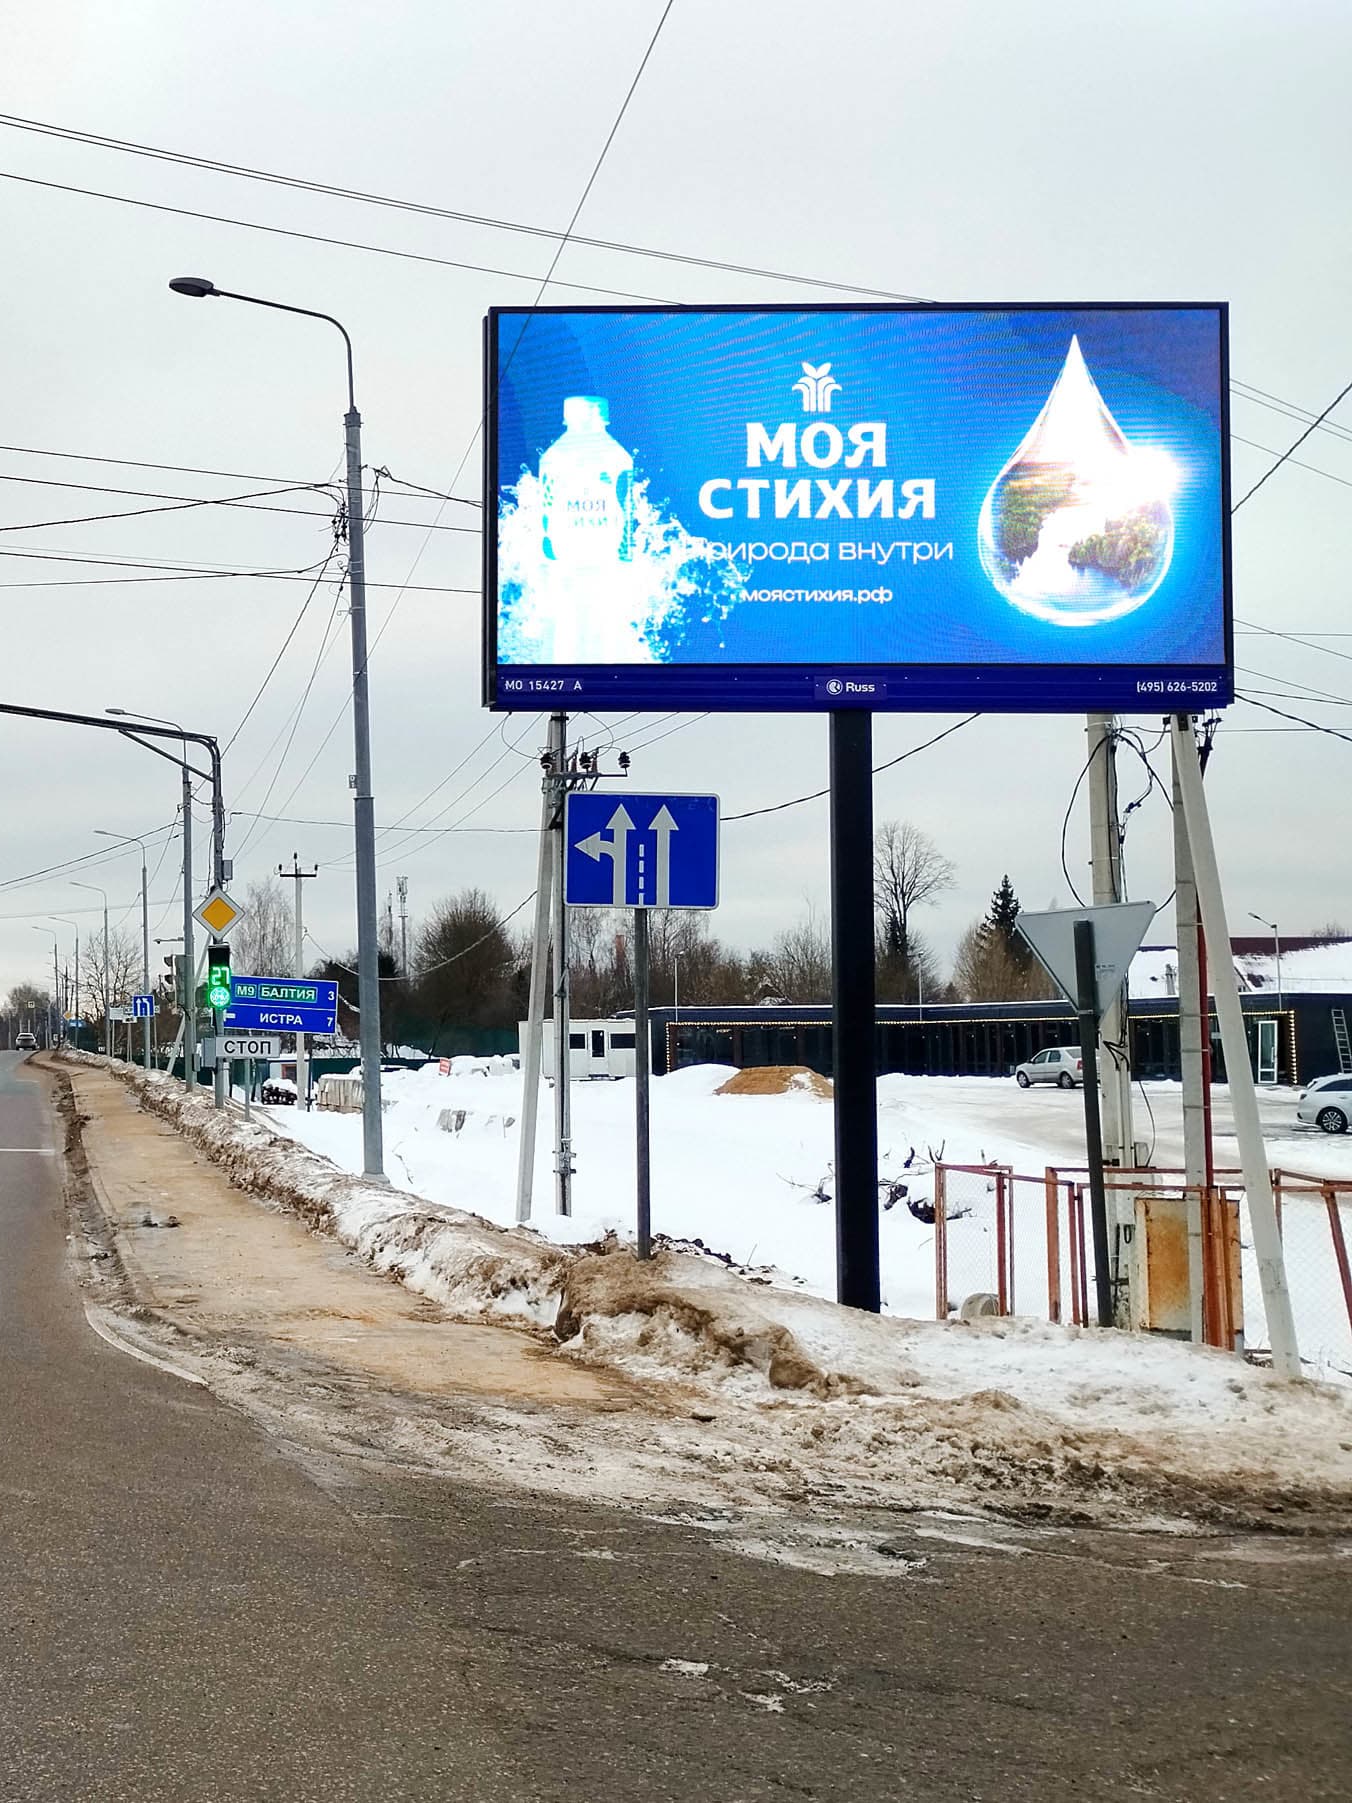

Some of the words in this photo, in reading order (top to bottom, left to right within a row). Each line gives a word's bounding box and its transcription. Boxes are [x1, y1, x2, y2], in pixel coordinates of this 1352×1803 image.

[746, 422, 887, 468] МОЯ
[698, 478, 936, 519] СТИХИЯ
[688, 541, 830, 564] рирода
[838, 541, 954, 565] внутри
[742, 586, 893, 604] моястихия.рф
[529, 680, 564, 691] 15427
[845, 682, 875, 692] Russ
[1136, 681, 1164, 693] (495)
[1167, 681, 1217, 692] 626-5202
[211, 966, 230, 986] 27
[261, 987, 316, 1000] БАЛТИЯ
[328, 991, 335, 1001] 3
[259, 1013, 303, 1025] ИСТРА
[327, 1017, 334, 1027] 7
[224, 1040, 272, 1055] СТОП
